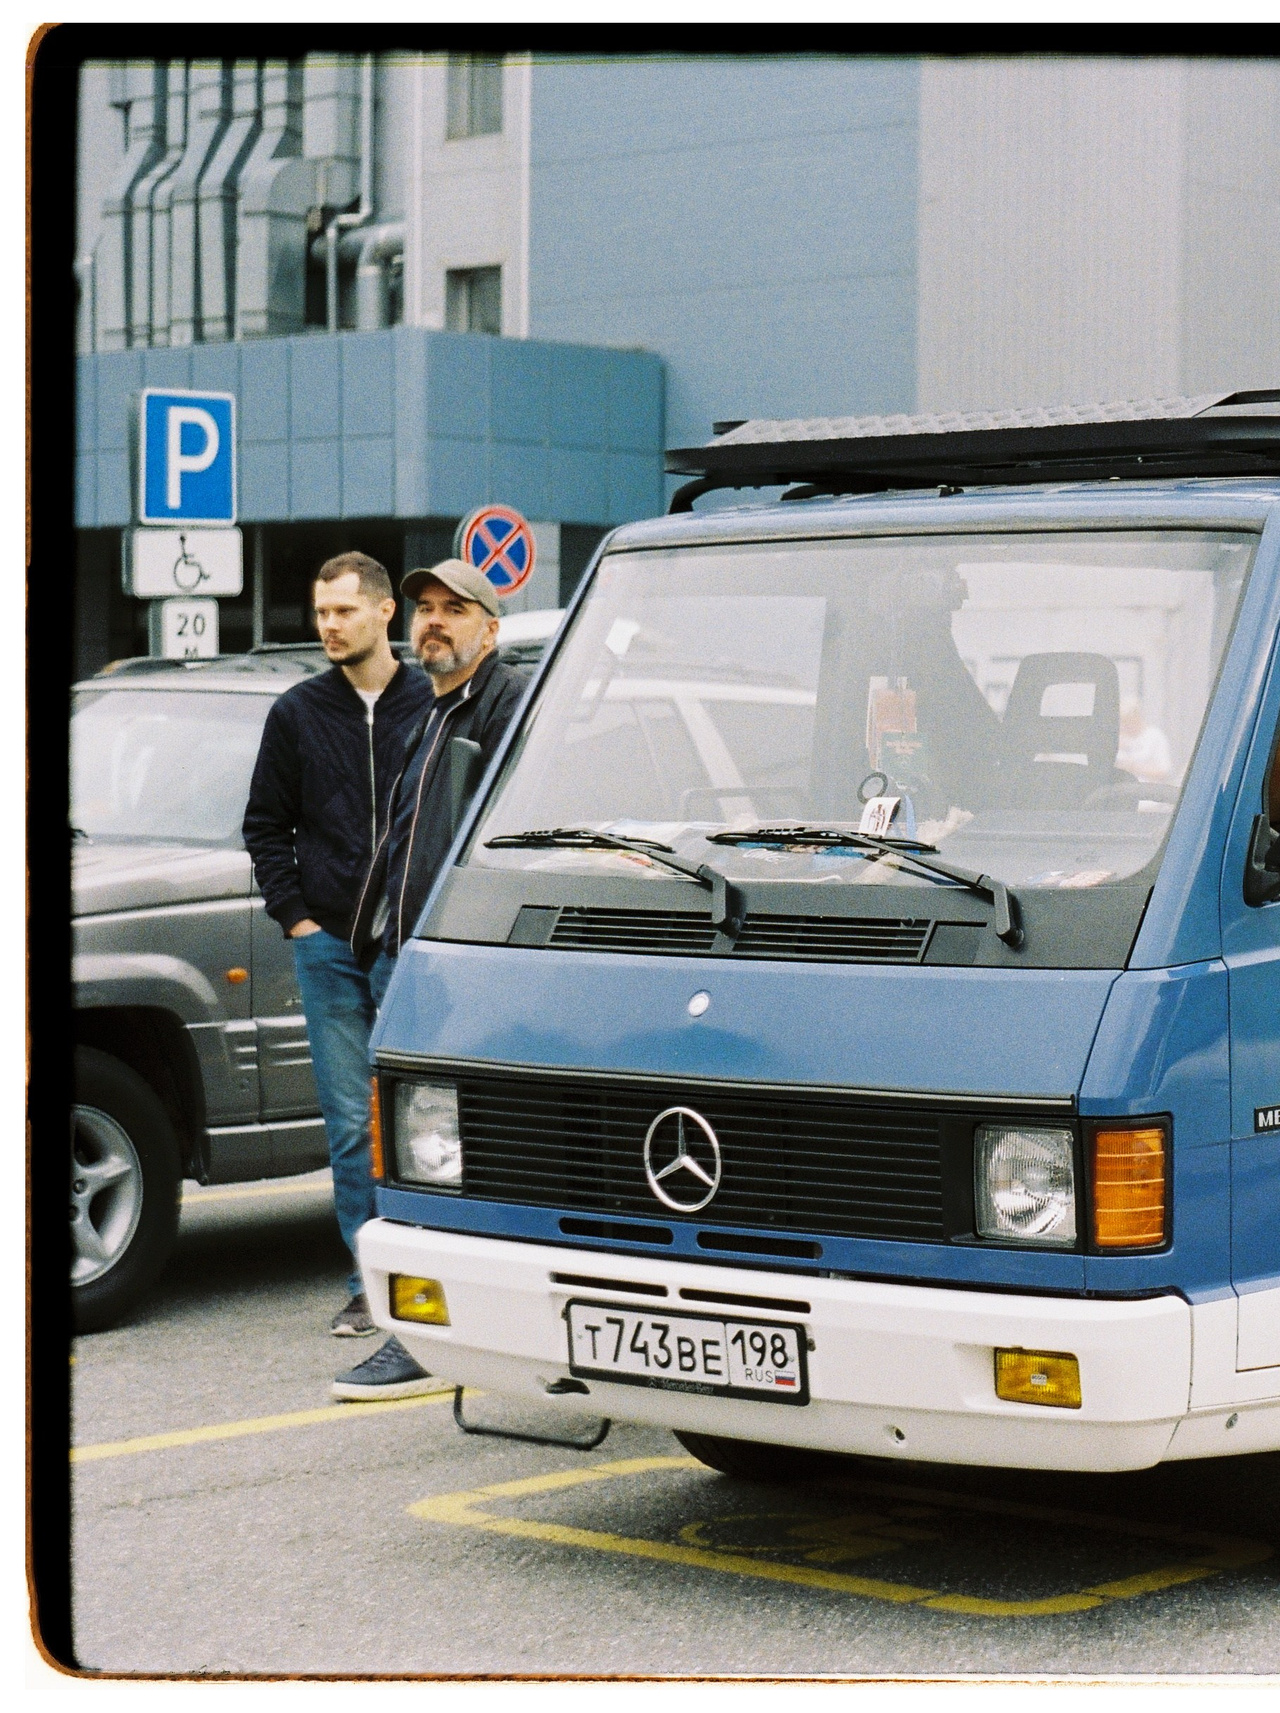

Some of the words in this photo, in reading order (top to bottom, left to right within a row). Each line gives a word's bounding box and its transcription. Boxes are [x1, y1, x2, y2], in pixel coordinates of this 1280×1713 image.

[168, 407, 219, 509] P
[177, 613, 205, 636] 20
[731, 1329, 789, 1369] 198
[745, 1367, 774, 1383] RUS
